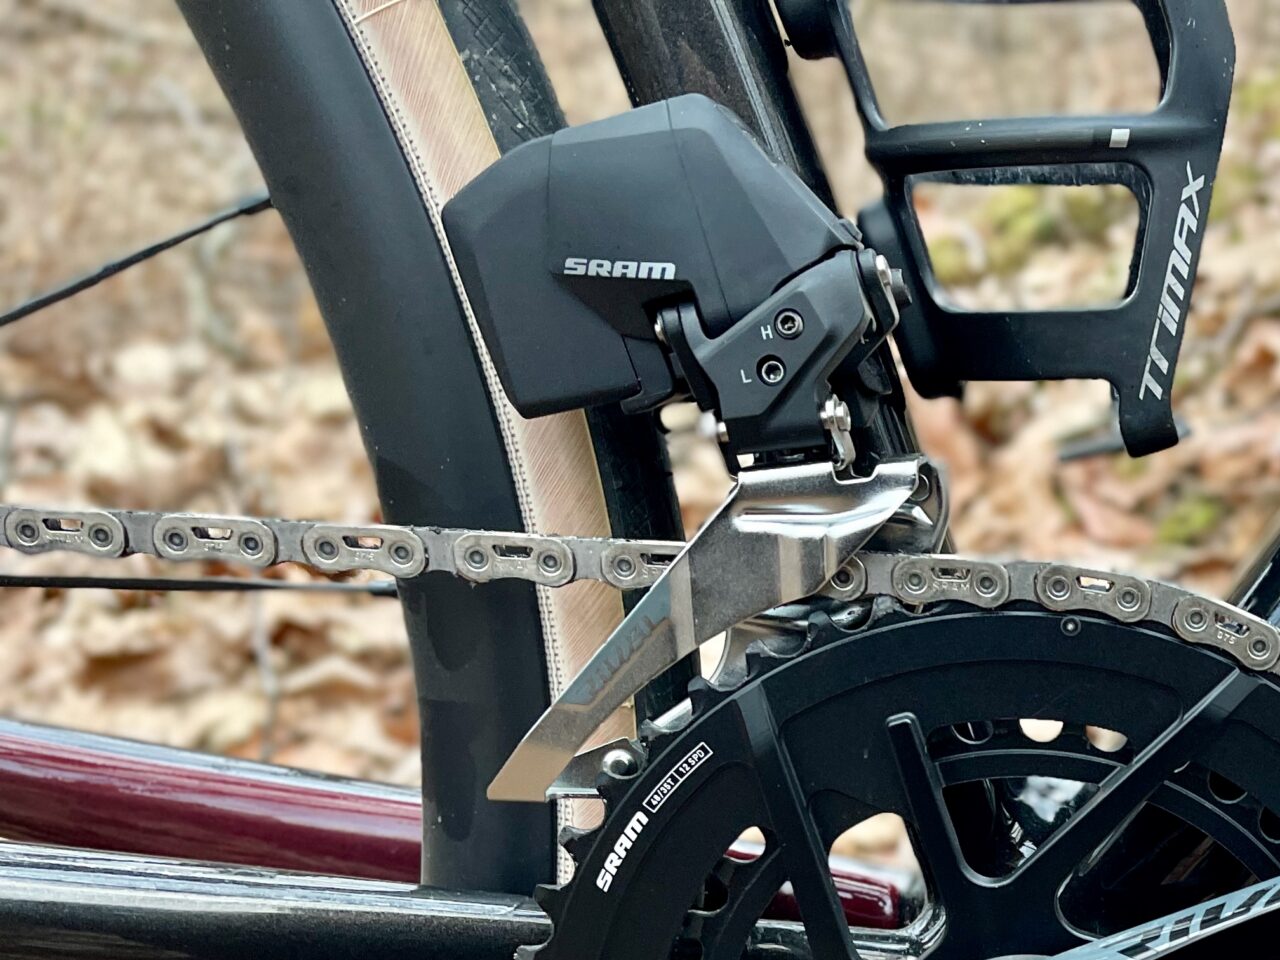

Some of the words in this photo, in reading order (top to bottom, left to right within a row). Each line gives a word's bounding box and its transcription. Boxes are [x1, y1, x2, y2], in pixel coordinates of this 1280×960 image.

[563, 257, 677, 280] SRAM
[760, 324, 774, 341] H
[739, 368, 753, 384] L
[932, 581, 971, 594] SRAM
[595, 810, 650, 893] SRAM
[678, 763, 690, 775] 12
[689, 749, 706, 766] SPD
